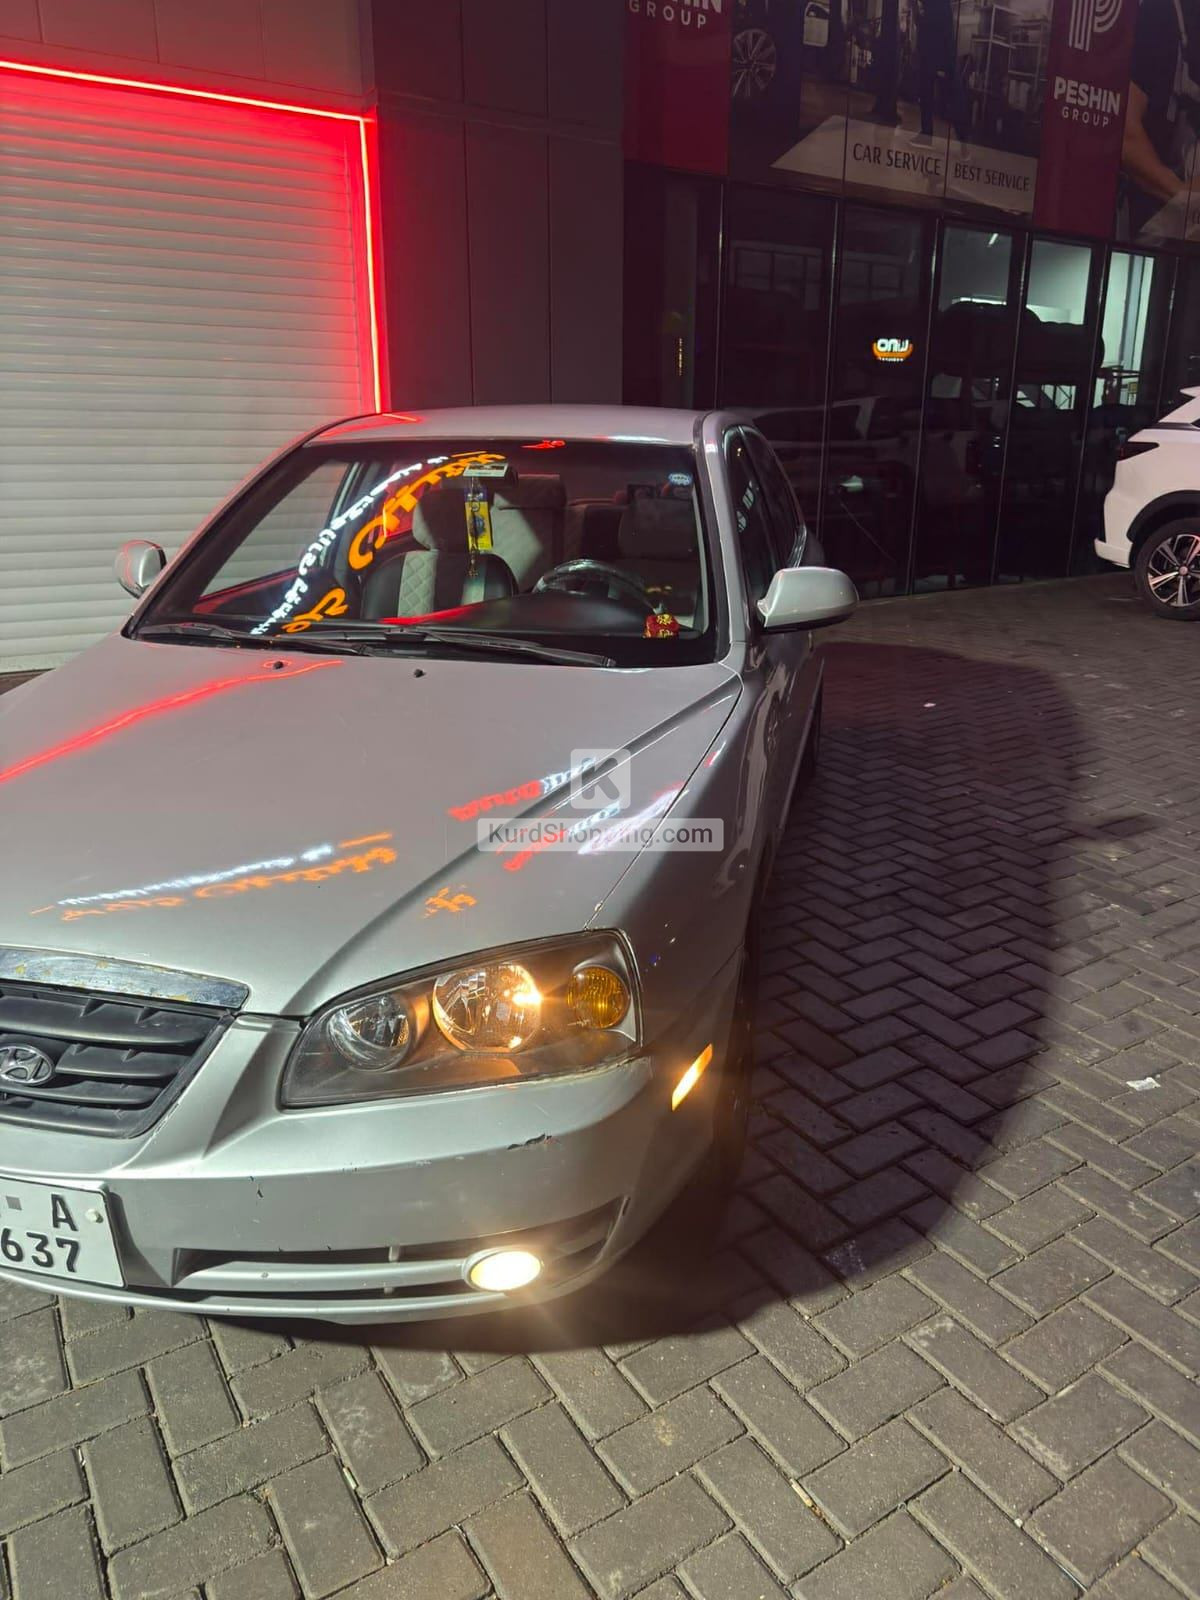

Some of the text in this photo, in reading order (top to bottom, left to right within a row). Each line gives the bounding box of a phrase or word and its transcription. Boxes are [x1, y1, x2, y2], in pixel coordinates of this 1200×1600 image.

[629, 0, 706, 28] GROUP
[1053, 75, 1121, 116] PESHIN
[1062, 106, 1110, 128] GROUP
[853, 143, 941, 176] CAR SERVICE
[954, 162, 1030, 192] BEST SERVICE
[51, 1193, 78, 1231] A
[0, 1228, 80, 1273] 637
